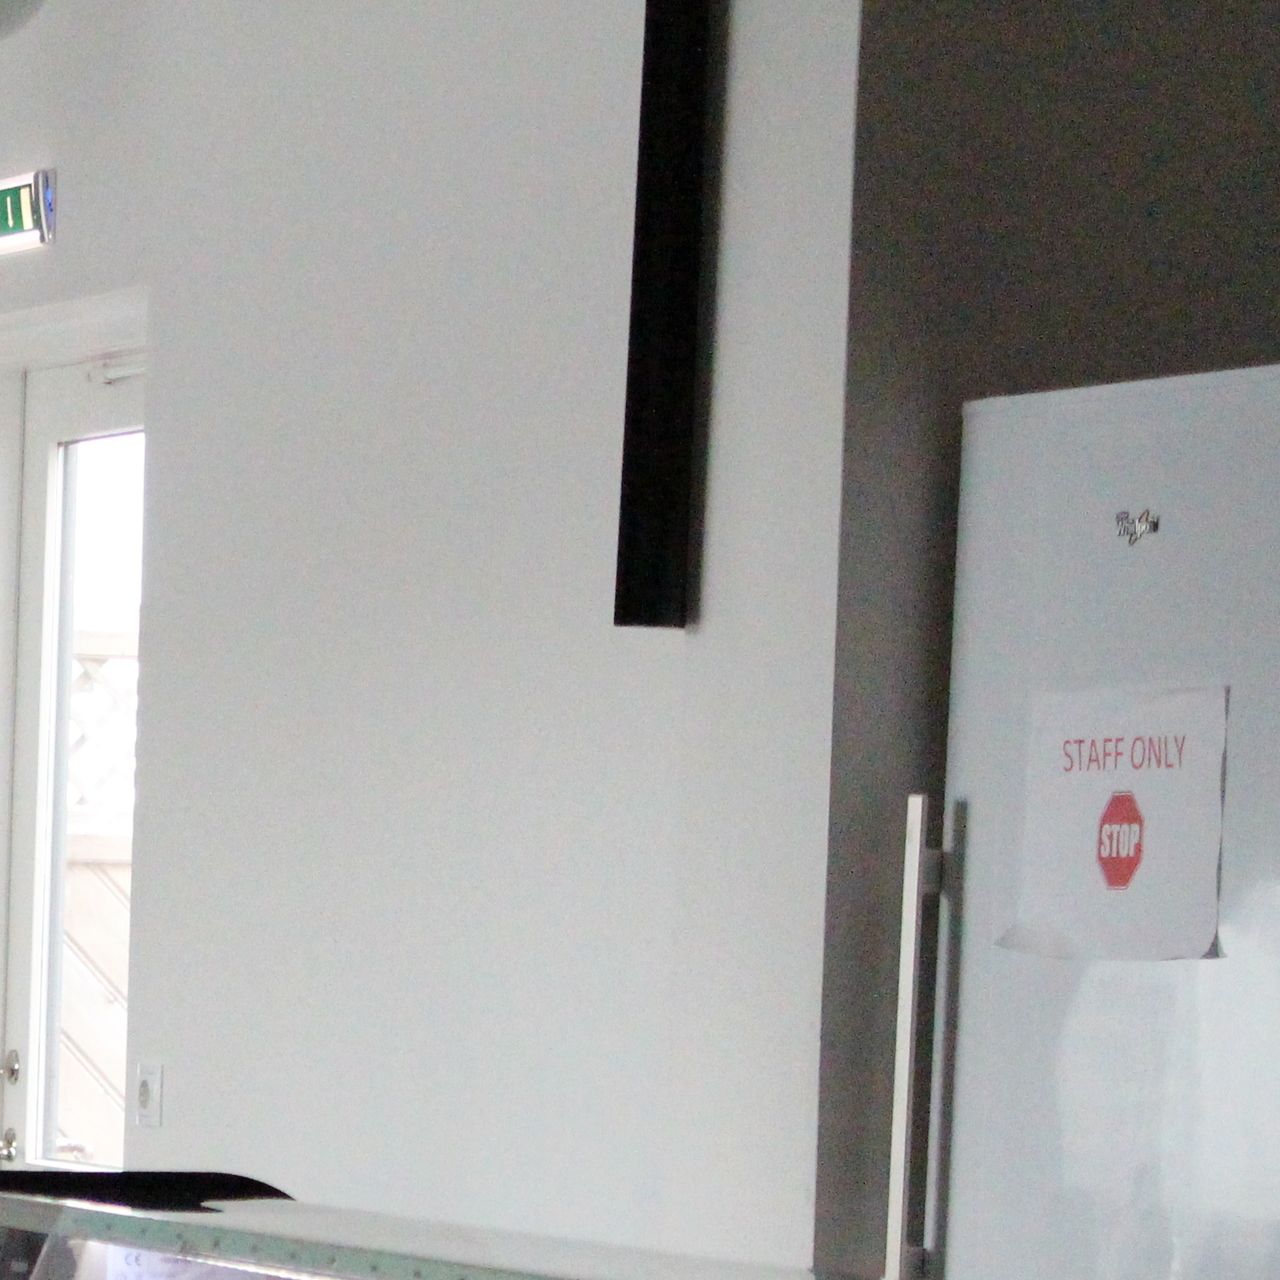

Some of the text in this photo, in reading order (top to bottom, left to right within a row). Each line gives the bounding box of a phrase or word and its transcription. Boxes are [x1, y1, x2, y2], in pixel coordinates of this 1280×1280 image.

[1062, 735, 1186, 773] STAFF ONLY
[1100, 823, 1142, 858] STOP
